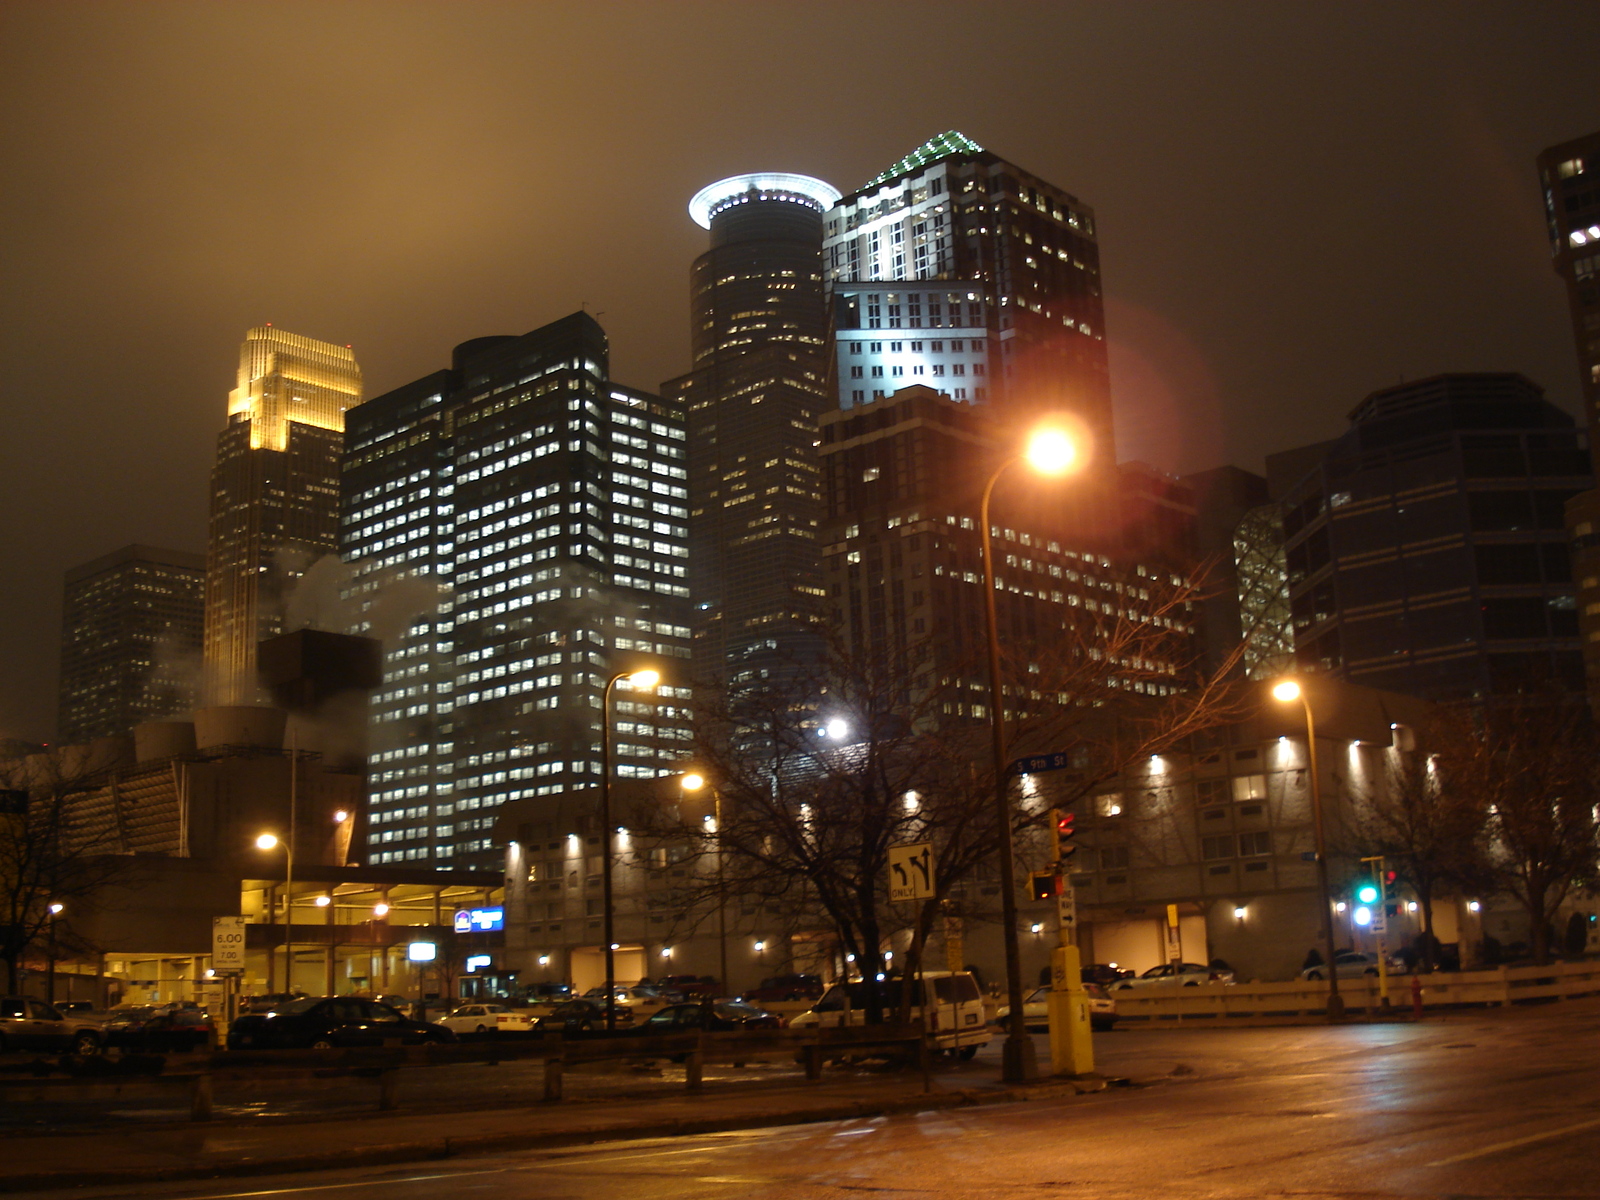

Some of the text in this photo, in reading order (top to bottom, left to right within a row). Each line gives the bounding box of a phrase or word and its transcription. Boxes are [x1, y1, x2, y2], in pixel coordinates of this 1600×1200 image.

[1017, 755, 1065, 772] S 9th St
[891, 888, 914, 898] ONLY
[216, 933, 242, 943] 6.00
